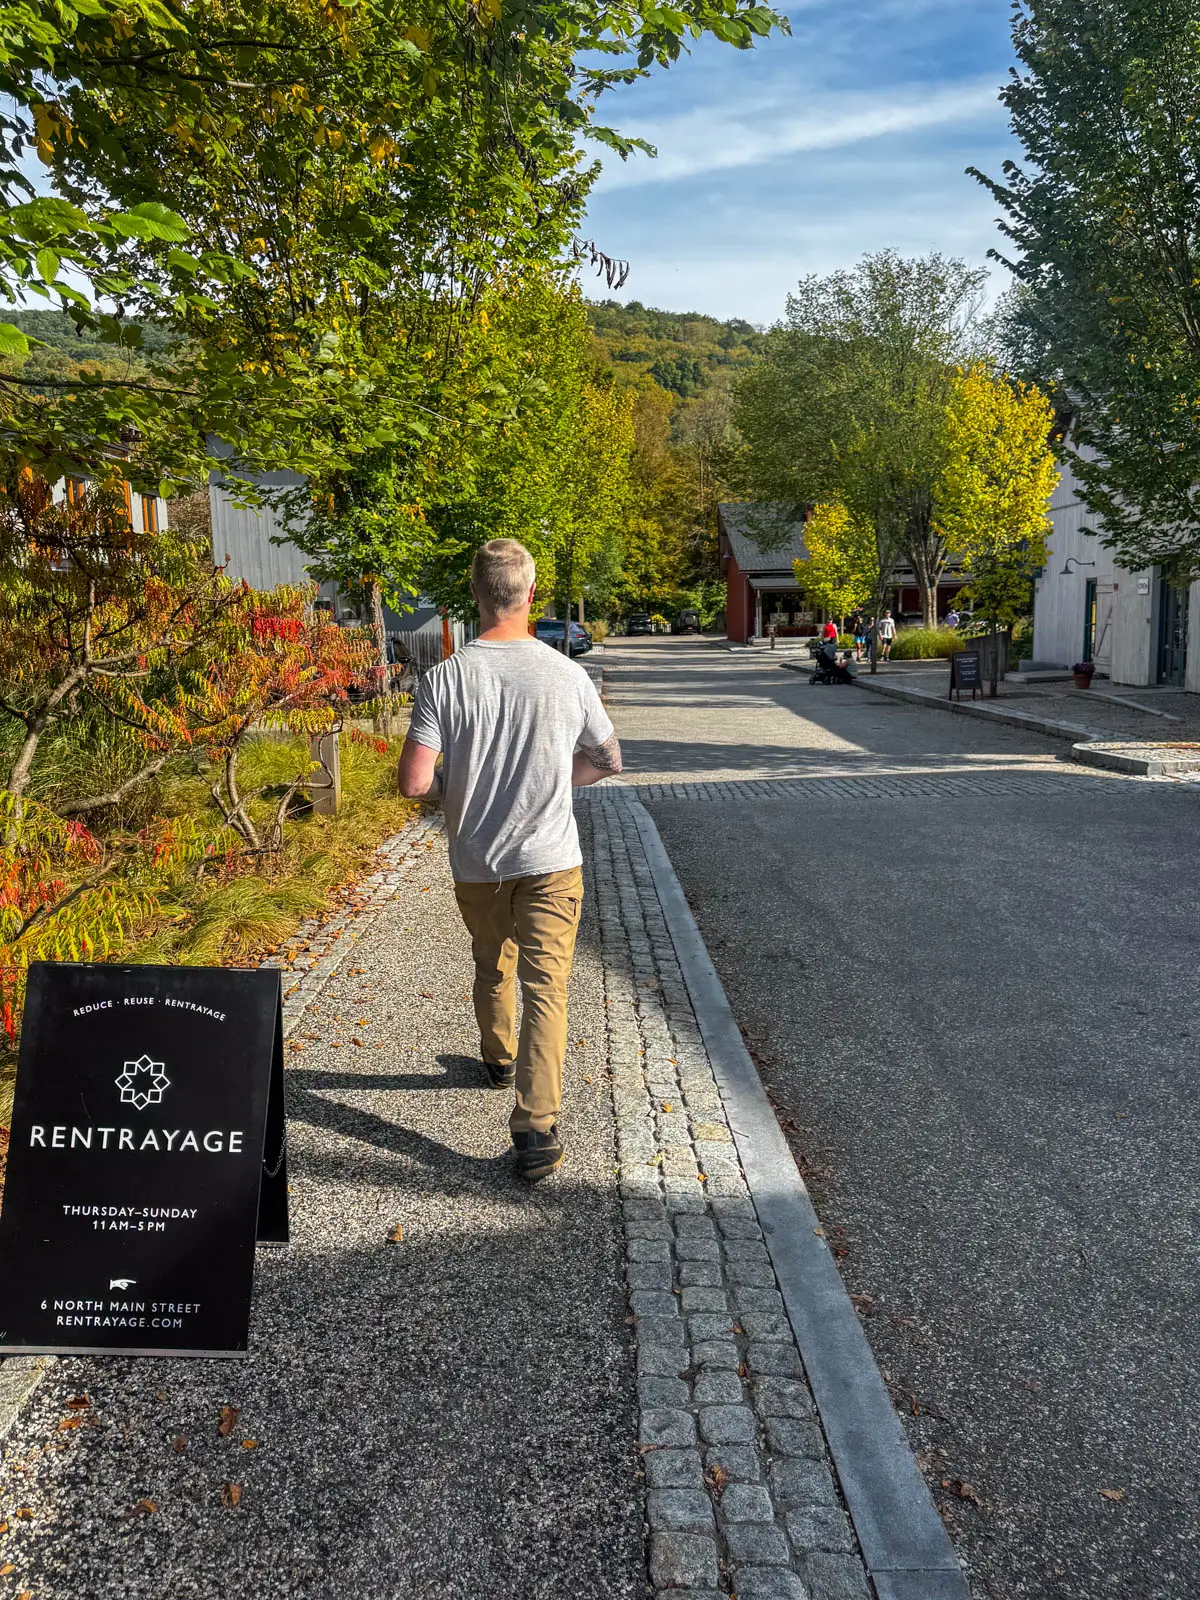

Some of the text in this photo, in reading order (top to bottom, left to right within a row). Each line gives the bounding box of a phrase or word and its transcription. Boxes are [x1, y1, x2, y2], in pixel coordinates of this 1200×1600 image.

[73, 997, 226, 1022] REDUCE REUSE RENTRAYAGE
[29, 1125, 244, 1153] RENTRAYAGE
[40, 1299, 201, 1314] 6 NORTH MAIN STREET
[56, 1315, 183, 1329] RENTRAYAGE.COM
